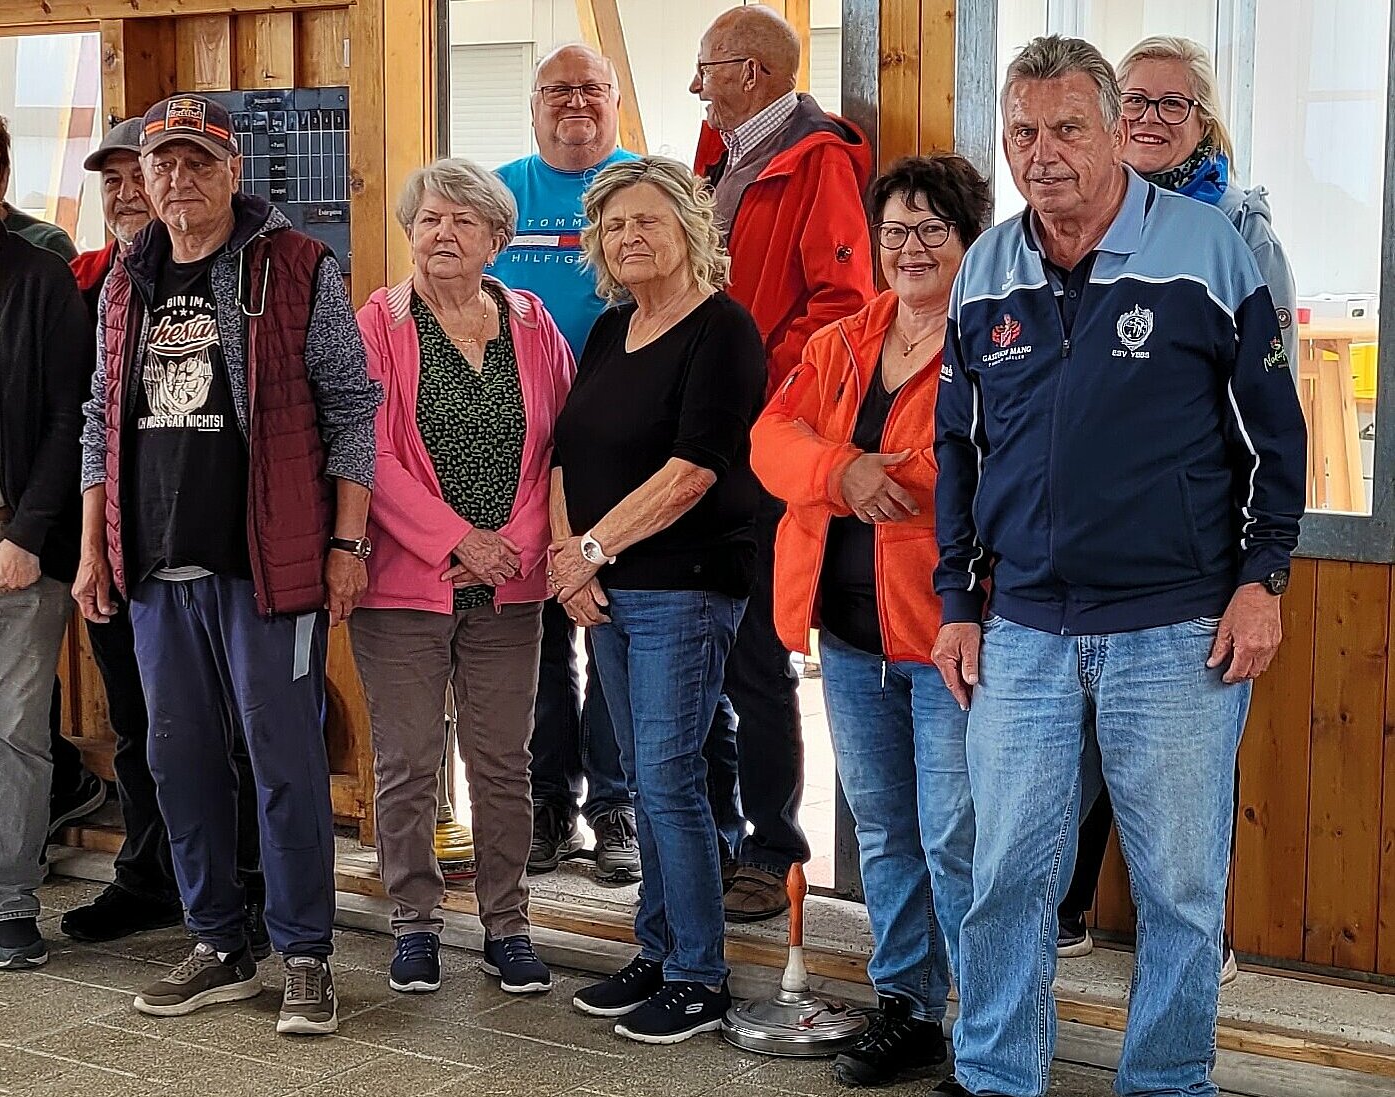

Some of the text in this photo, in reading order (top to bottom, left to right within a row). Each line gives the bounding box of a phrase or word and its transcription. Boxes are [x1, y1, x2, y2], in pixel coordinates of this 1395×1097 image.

[527, 218, 582, 227] TOMM
[511, 253, 585, 264] HILFIGE
[166, 295, 204, 309] BIN IM
[166, 414, 185, 428] GAR
